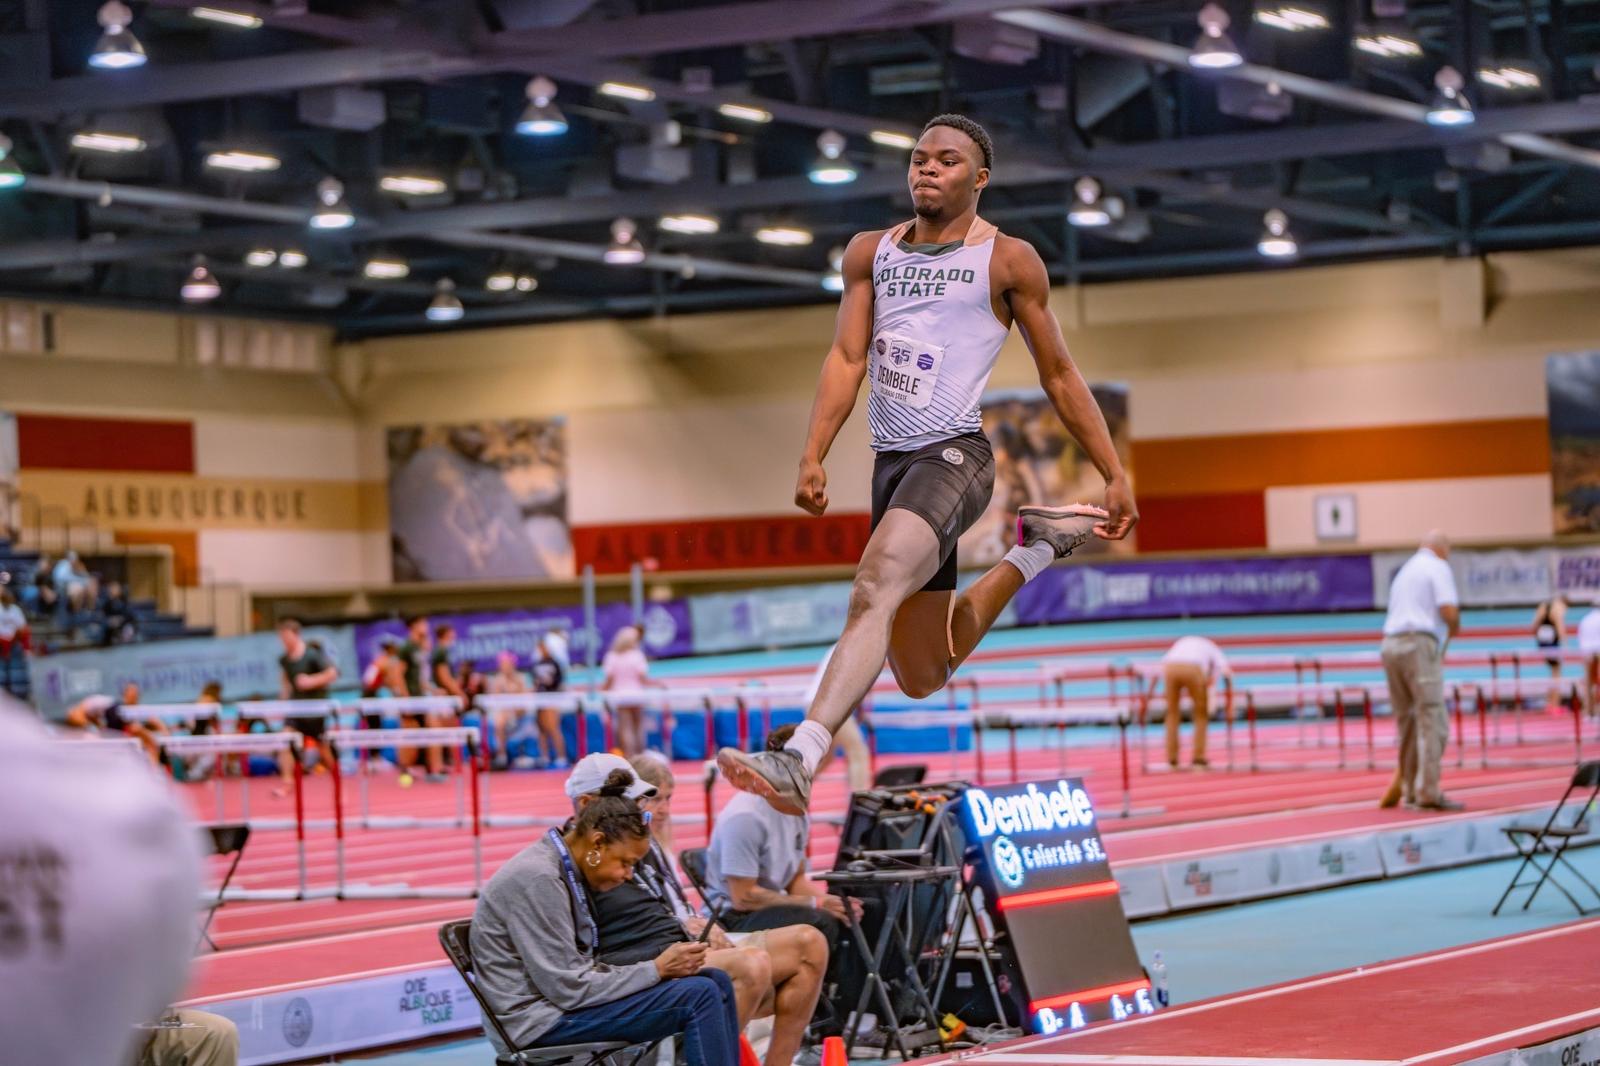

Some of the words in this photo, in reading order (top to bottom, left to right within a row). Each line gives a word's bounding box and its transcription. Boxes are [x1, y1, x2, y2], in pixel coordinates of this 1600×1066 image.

[875, 266, 975, 286] COLORADO
[887, 281, 947, 297] STATE
[878, 365, 921, 395] DEMBELE
[84, 486, 305, 521] ALBUQUERQUE
[966, 780, 1094, 837] Dembele
[1021, 839, 1083, 869] Colorado
[1084, 838, 1107, 862] St.
[404, 977, 427, 995] ONE
